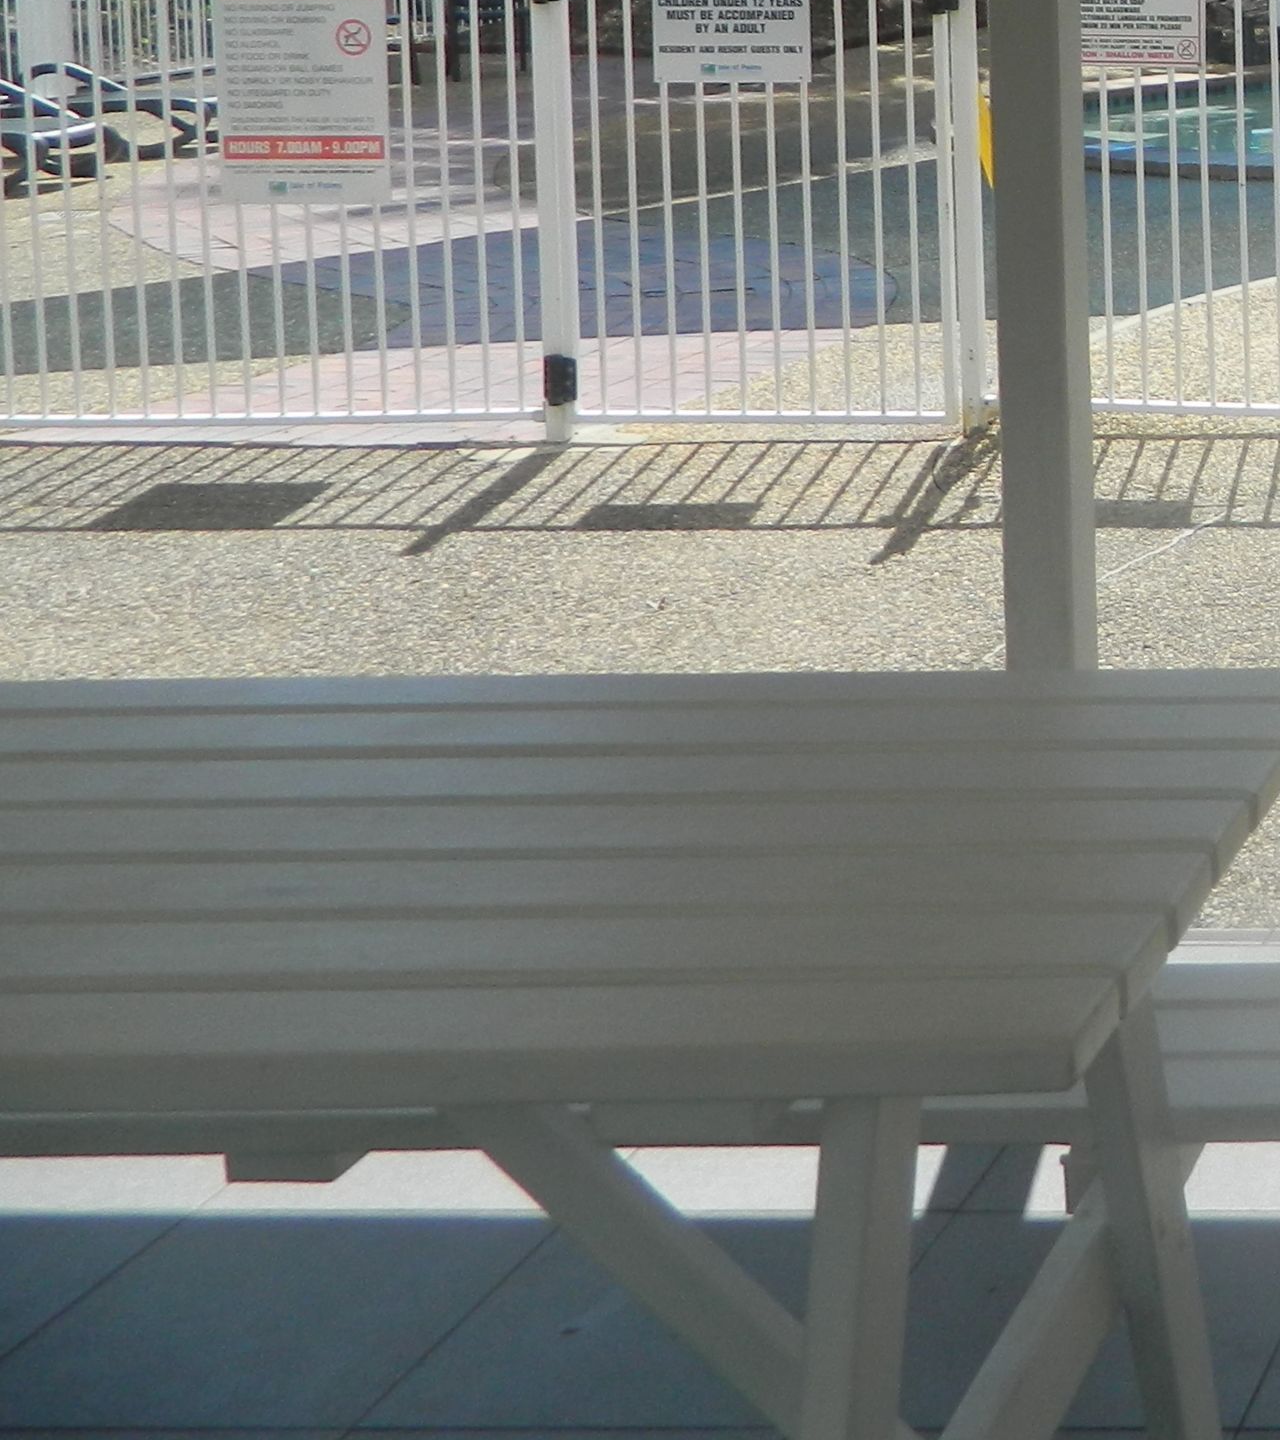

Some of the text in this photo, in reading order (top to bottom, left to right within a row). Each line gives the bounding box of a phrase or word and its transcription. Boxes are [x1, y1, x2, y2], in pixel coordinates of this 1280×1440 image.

[667, 10, 795, 20] MUST BE ACCOMPANIED
[696, 23, 766, 33] BY AN ADULT
[229, 141, 270, 154] HOURS
[277, 141, 322, 154] 7.00AM
[332, 141, 380, 154] 9.00PM
